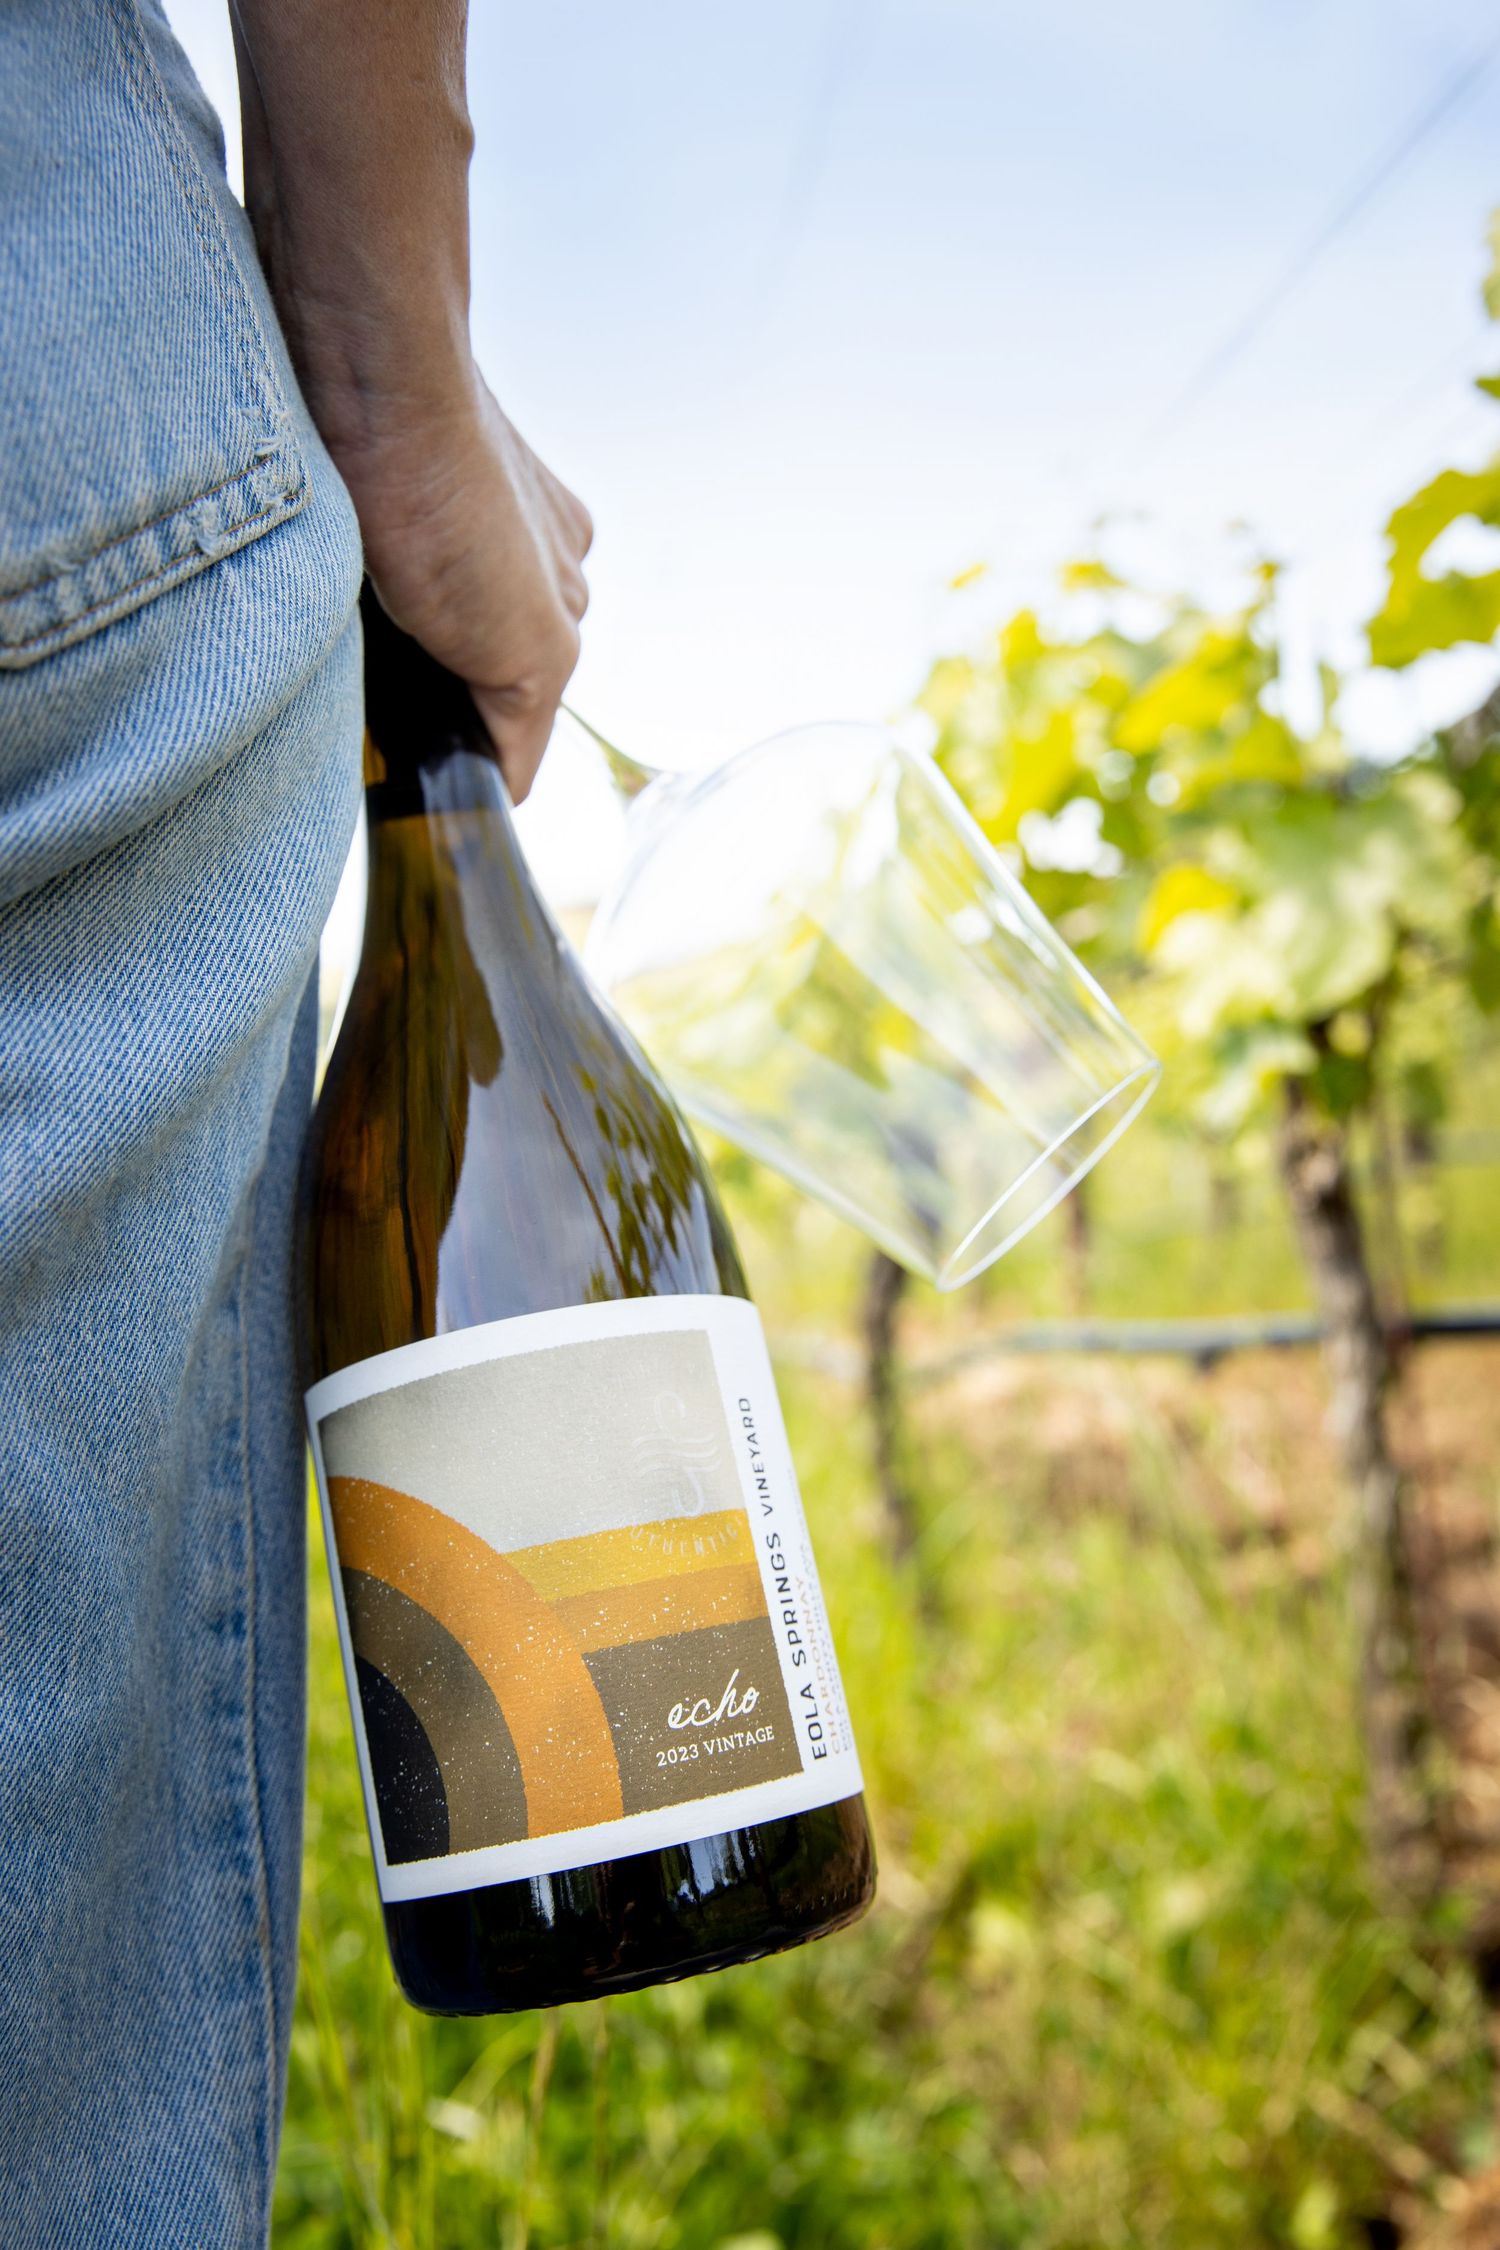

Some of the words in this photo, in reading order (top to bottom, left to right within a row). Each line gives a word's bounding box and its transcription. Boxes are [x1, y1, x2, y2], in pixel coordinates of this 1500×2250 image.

[738, 1397, 774, 1517] VINEYARD
[766, 1532, 807, 1668] SPRINGS
[667, 1668, 760, 1729] echo
[795, 1575, 841, 1755] CHARDONNAY
[655, 1743, 700, 1767] 2023
[702, 1725, 775, 1755] VINTAGE
[800, 1683, 828, 1760] EOLA
